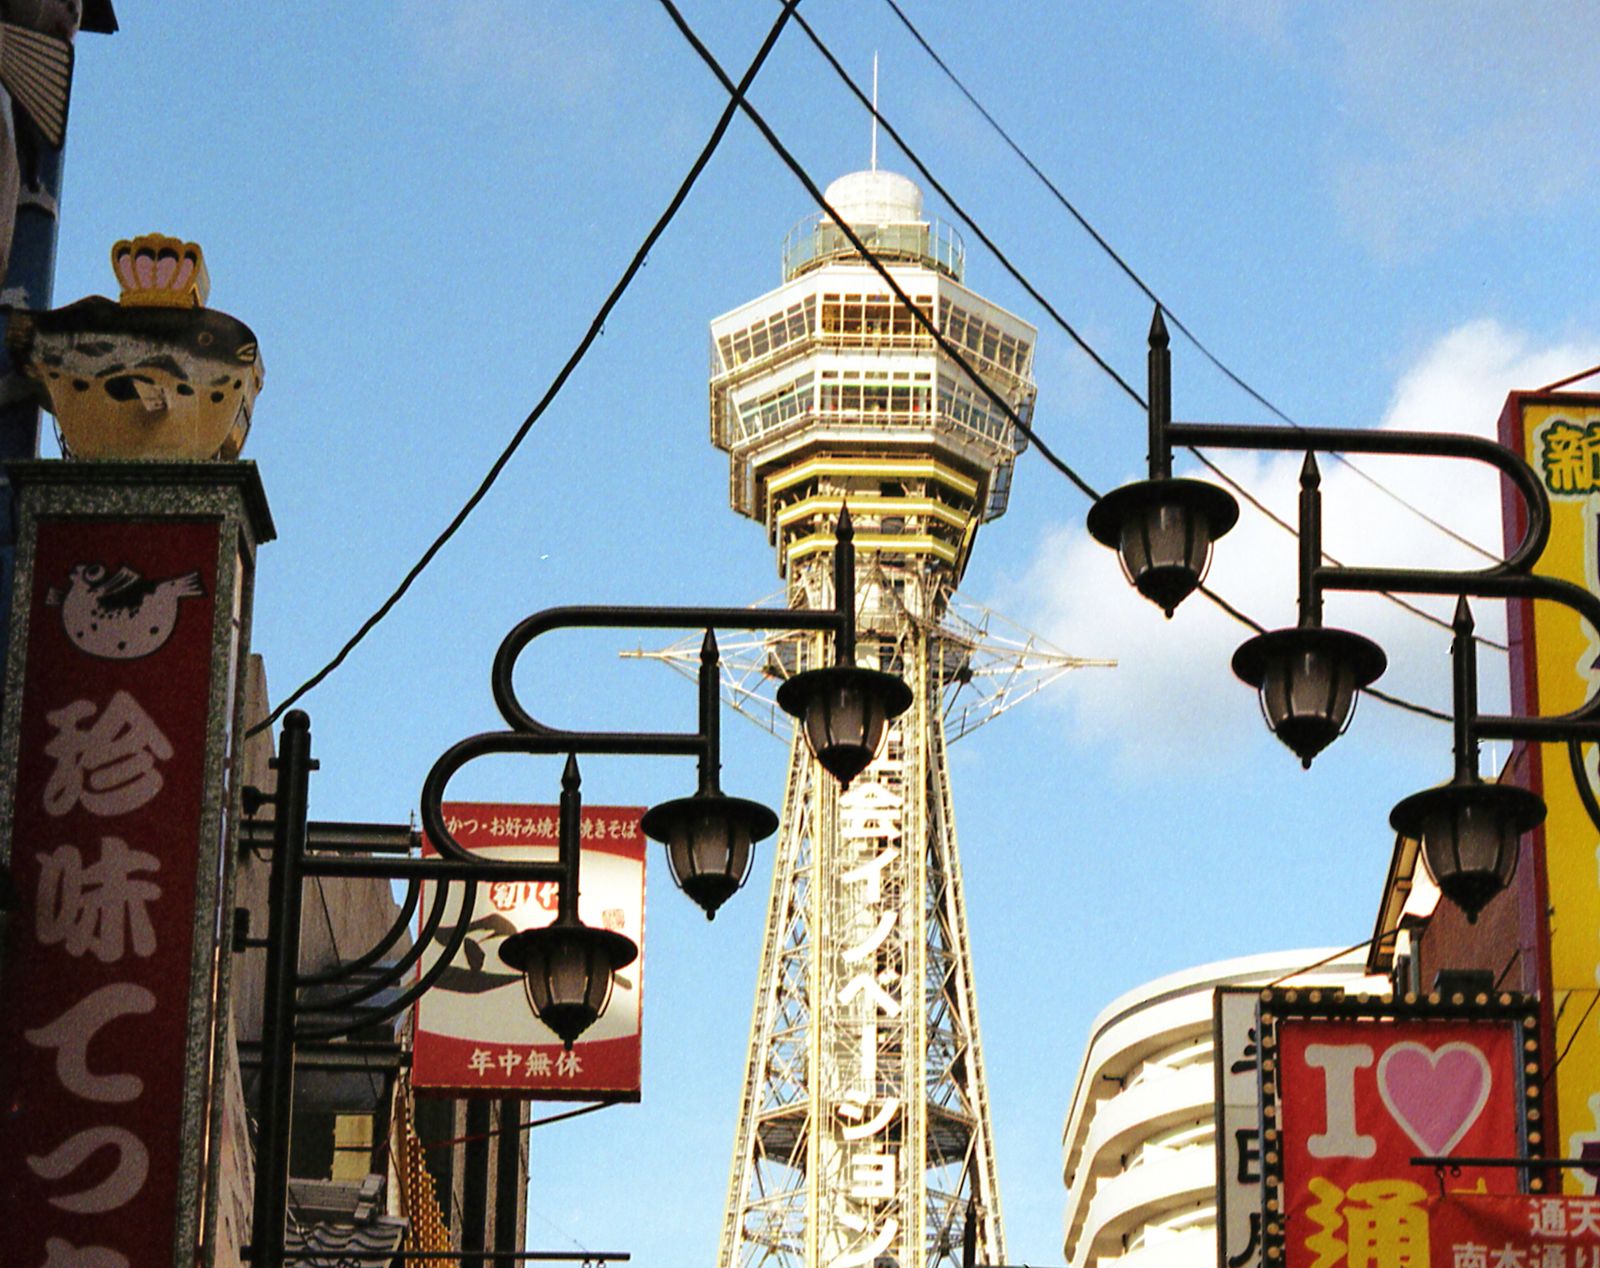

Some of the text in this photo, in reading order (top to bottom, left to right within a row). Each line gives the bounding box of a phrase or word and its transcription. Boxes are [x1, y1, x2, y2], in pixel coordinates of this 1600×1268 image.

[1547, 423, 1600, 494] 新
[467, 1047, 585, 1079] 年中無休
[1304, 1043, 1377, 1159] I
[1529, 1198, 1600, 1238] 通天
